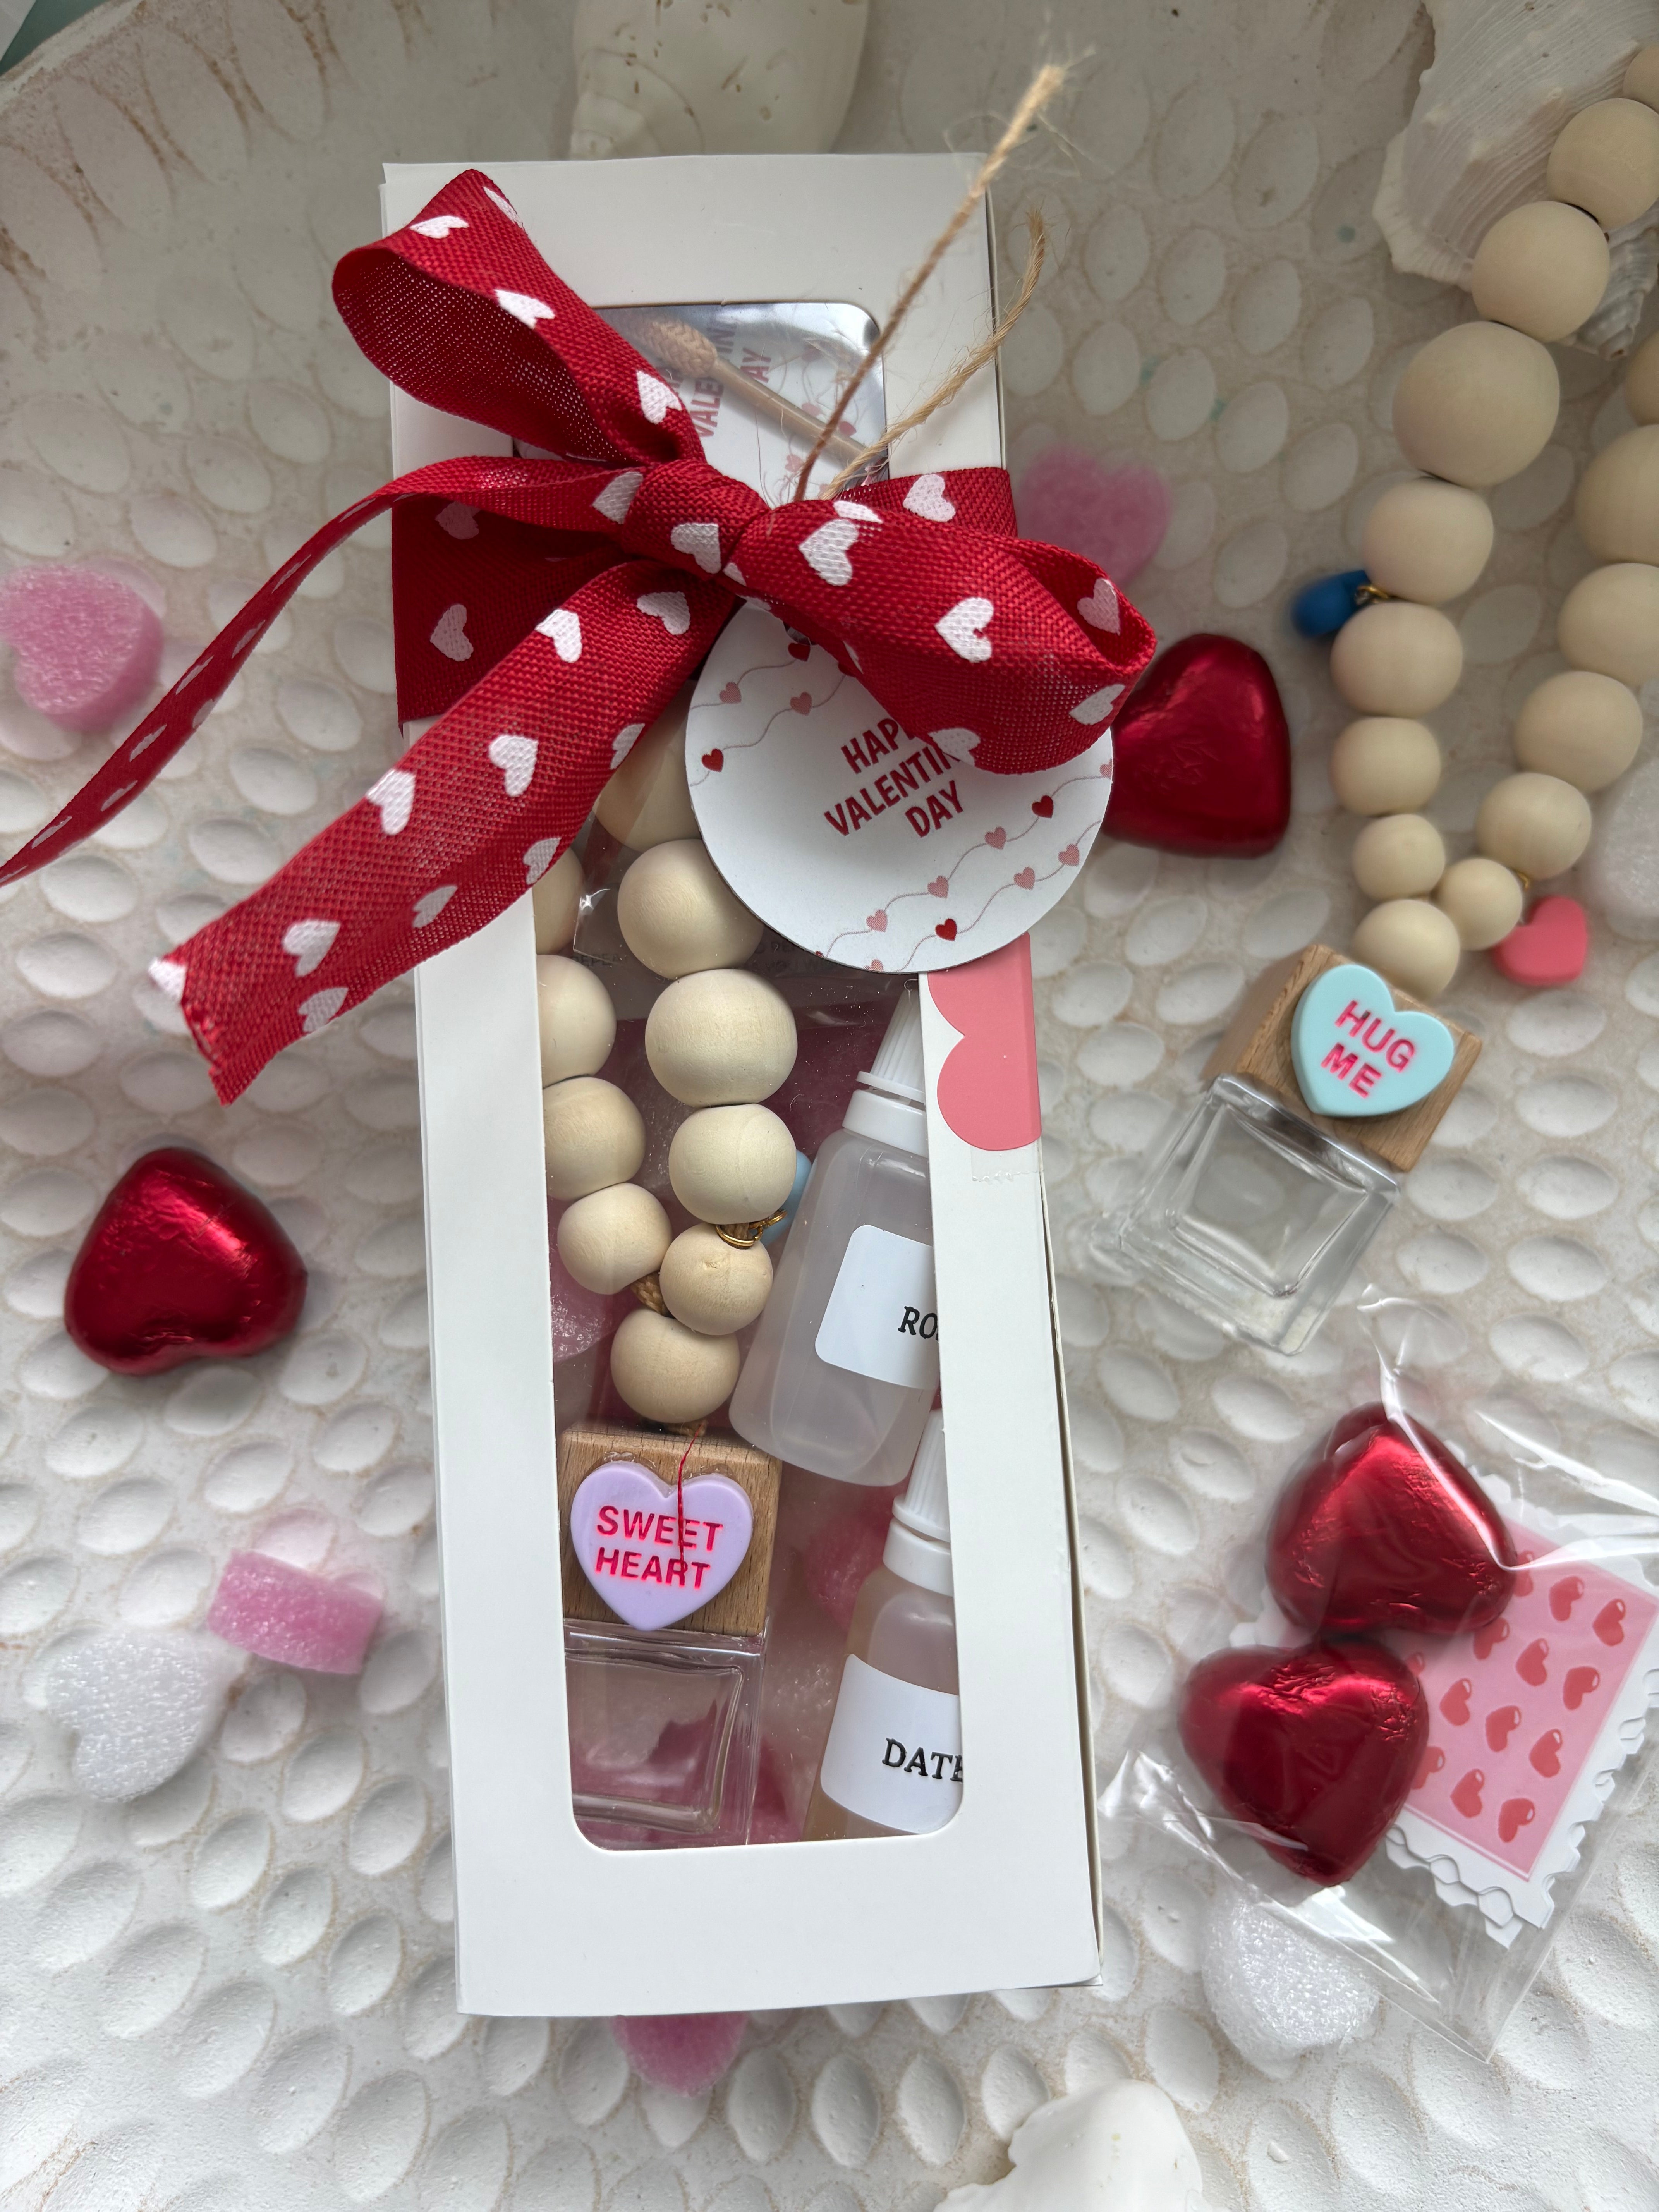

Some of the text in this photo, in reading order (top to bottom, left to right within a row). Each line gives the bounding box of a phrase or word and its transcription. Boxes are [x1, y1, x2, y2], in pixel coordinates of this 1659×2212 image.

[841, 718, 915, 774] HAP
[905, 780, 963, 838] DAY
[1334, 1000, 1415, 1073] HUG
[1320, 1042, 1382, 1099] ME
[897, 1305, 939, 1341] RO
[596, 1505, 724, 1552] SWEET
[595, 1547, 711, 1590] HEART
